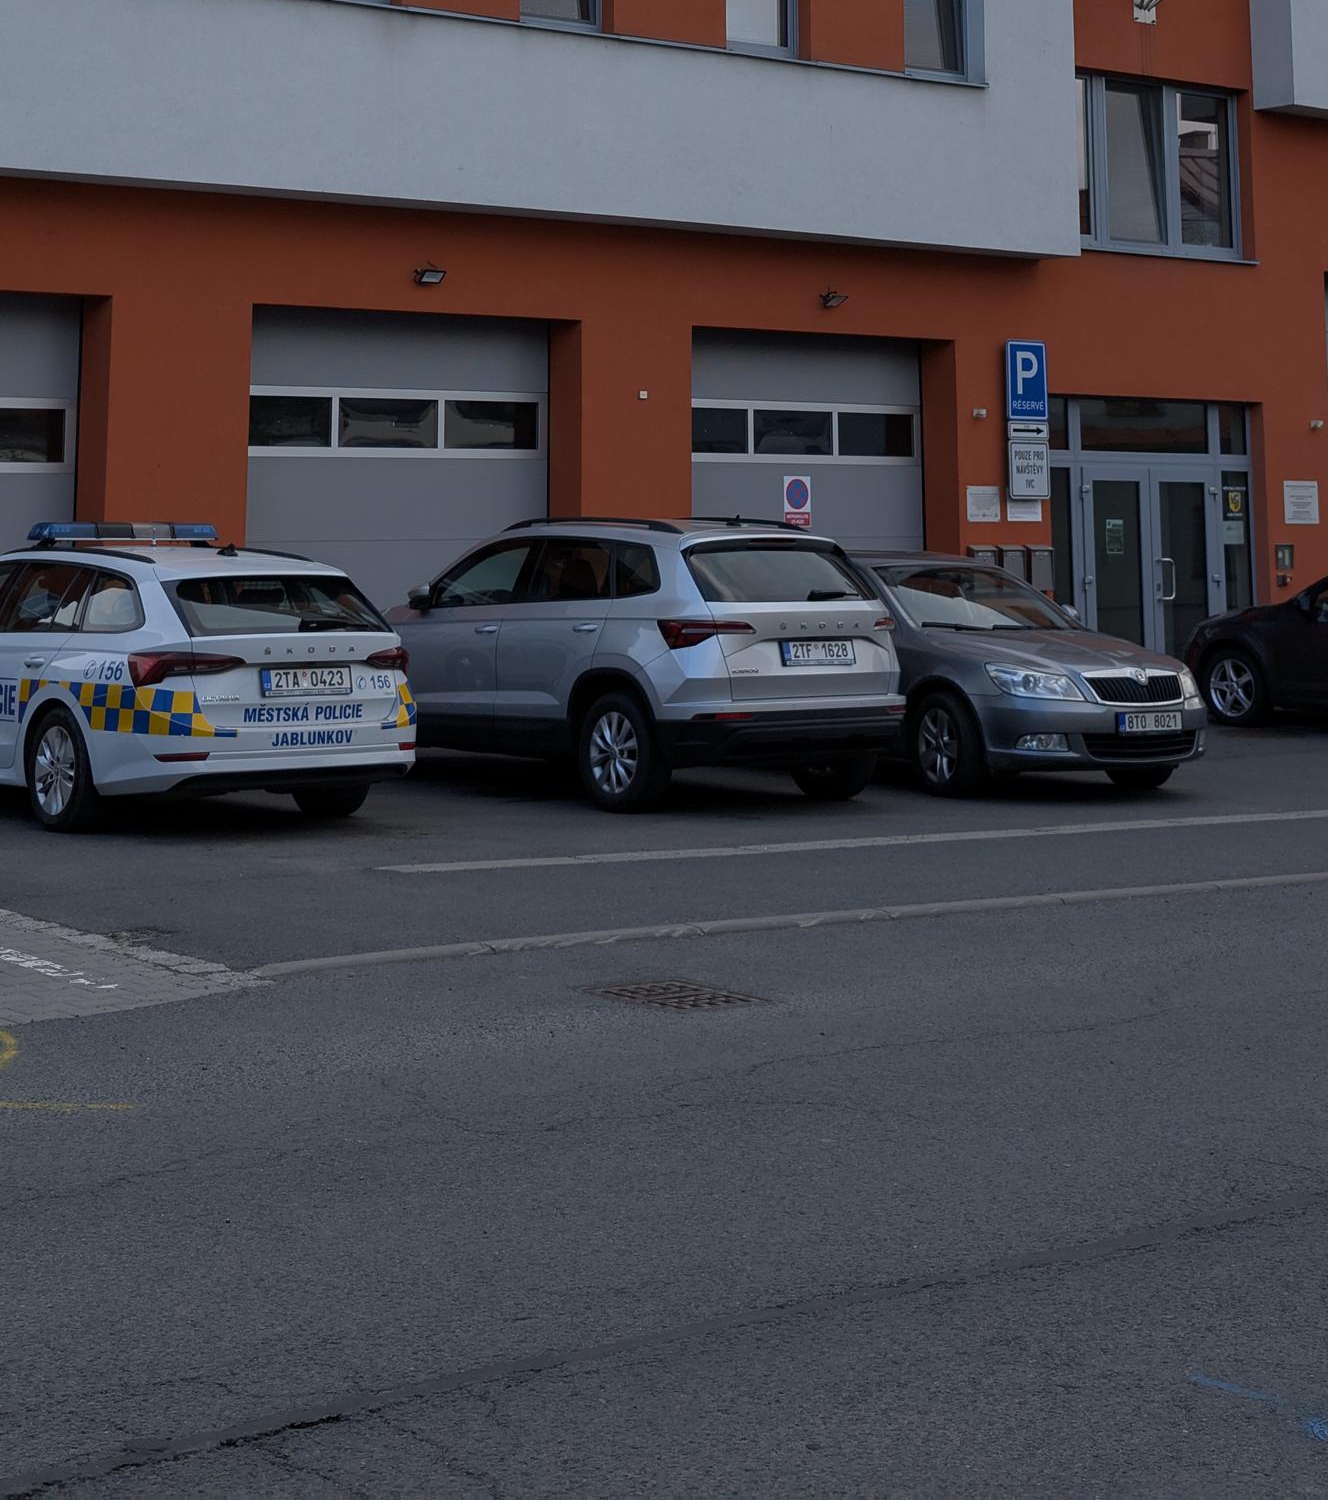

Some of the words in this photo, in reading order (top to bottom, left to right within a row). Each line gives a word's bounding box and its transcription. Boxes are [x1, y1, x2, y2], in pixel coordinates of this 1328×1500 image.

[1016, 351, 1039, 395] P
[1012, 399, 1045, 411] RÉSERVÉ
[1014, 450, 1032, 460] POUZE
[1033, 451, 1044, 461] PRO
[1025, 479, 1035, 489] IVC
[264, 646, 356, 655] ŠKODA
[792, 643, 812, 659] 2TF
[822, 642, 848, 658] 1628
[98, 660, 125, 681] 156
[274, 671, 300, 688] 2TA
[310, 670, 344, 687] 0423
[370, 674, 392, 690] 156
[243, 702, 310, 723] MĚSTSKÁ
[315, 704, 363, 721] POLICIE
[1154, 714, 1178, 728] 8021
[271, 729, 353, 747] JABLUNKOV
